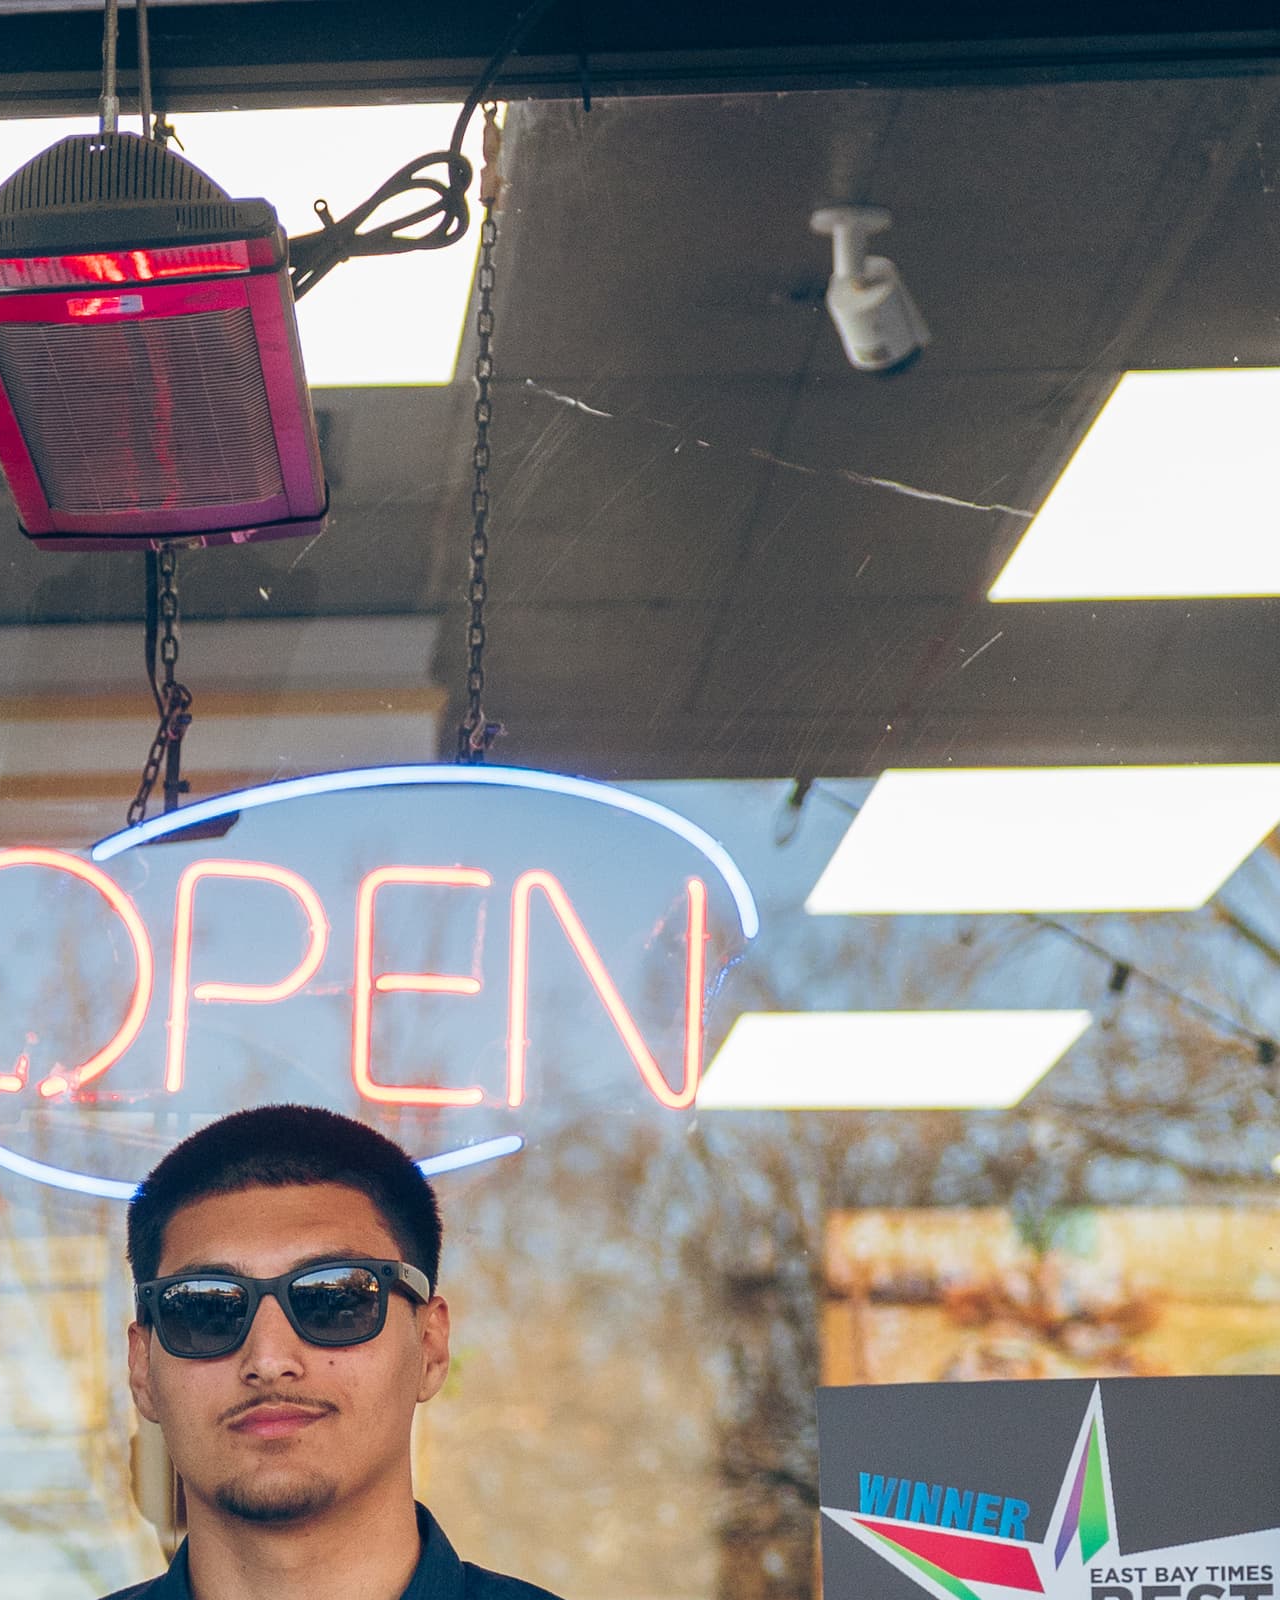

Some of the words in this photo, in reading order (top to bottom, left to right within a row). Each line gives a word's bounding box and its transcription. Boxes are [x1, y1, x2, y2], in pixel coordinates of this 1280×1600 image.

[859, 1471, 1030, 1541] WINNER
[1090, 1567, 1147, 1584] EAST
[1155, 1567, 1198, 1583] BAY
[1206, 1565, 1273, 1582] TIMES
